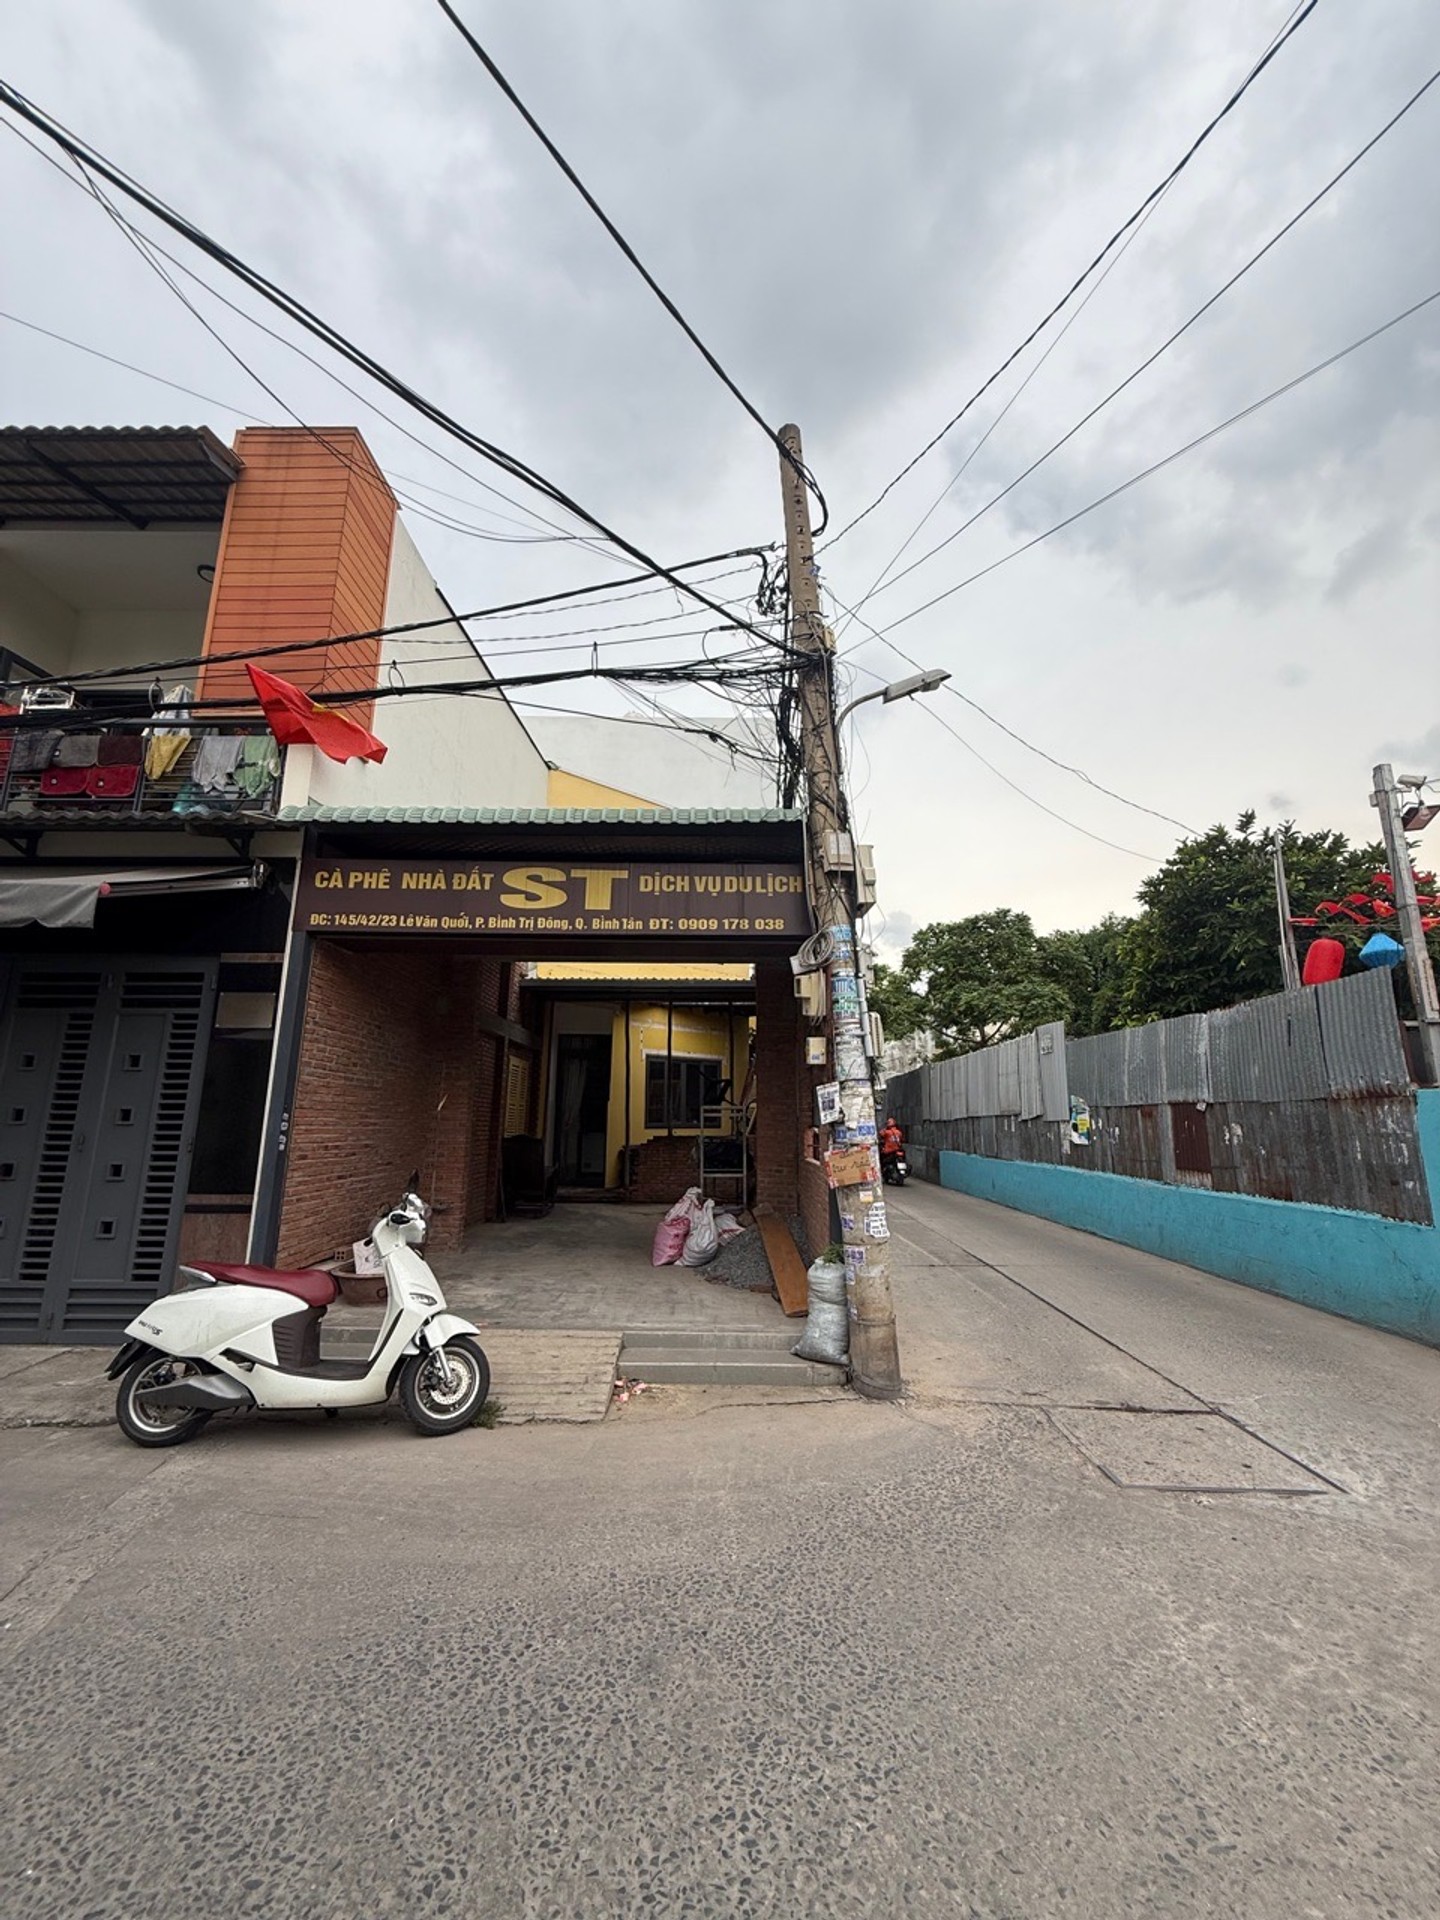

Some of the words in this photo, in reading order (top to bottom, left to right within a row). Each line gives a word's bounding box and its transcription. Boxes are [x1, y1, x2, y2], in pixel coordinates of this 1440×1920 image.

[314, 867, 343, 889] CÀ
[348, 868, 391, 889] PHÊ
[401, 868, 447, 890] NHÀ
[452, 865, 494, 891] ĐẤT
[500, 866, 629, 911] ST
[639, 871, 690, 896] DỊCH
[694, 875, 721, 897] VỤ
[724, 875, 753, 893] DU
[755, 872, 803, 897] LỊCH
[310, 913, 331, 926] ĐC:
[334, 913, 397, 927] 145/42/23
[400, 915, 414, 927] Lê
[415, 915, 438, 928] Văn
[475, 916, 486, 929] P.
[488, 914, 516, 929] Bình
[519, 916, 534, 931] Trị
[537, 916, 573, 931] Đông,
[575, 917, 588, 930] Q.
[592, 915, 620, 930] Bình
[621, 917, 643, 930] Tân
[649, 917, 674, 931] ĐT:
[678, 918, 719, 930] 0909
[722, 918, 750, 930] 178
[754, 918, 785, 930] 038
